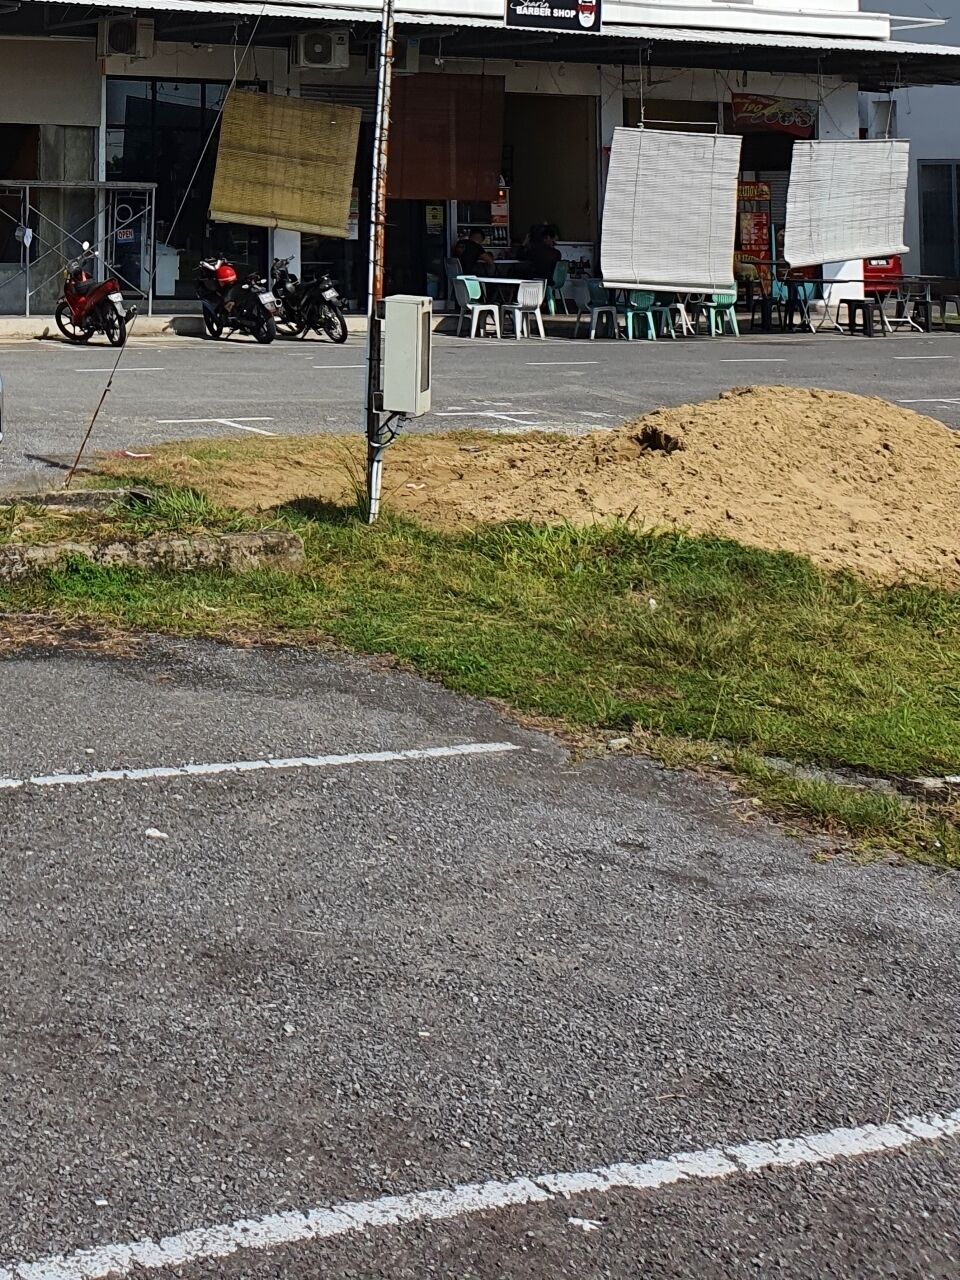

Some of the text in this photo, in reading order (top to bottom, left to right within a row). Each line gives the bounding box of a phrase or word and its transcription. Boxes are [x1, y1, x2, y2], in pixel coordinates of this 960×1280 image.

[516, 6, 576, 18] BARBER SHOP
[118, 230, 133, 239] OPEN
